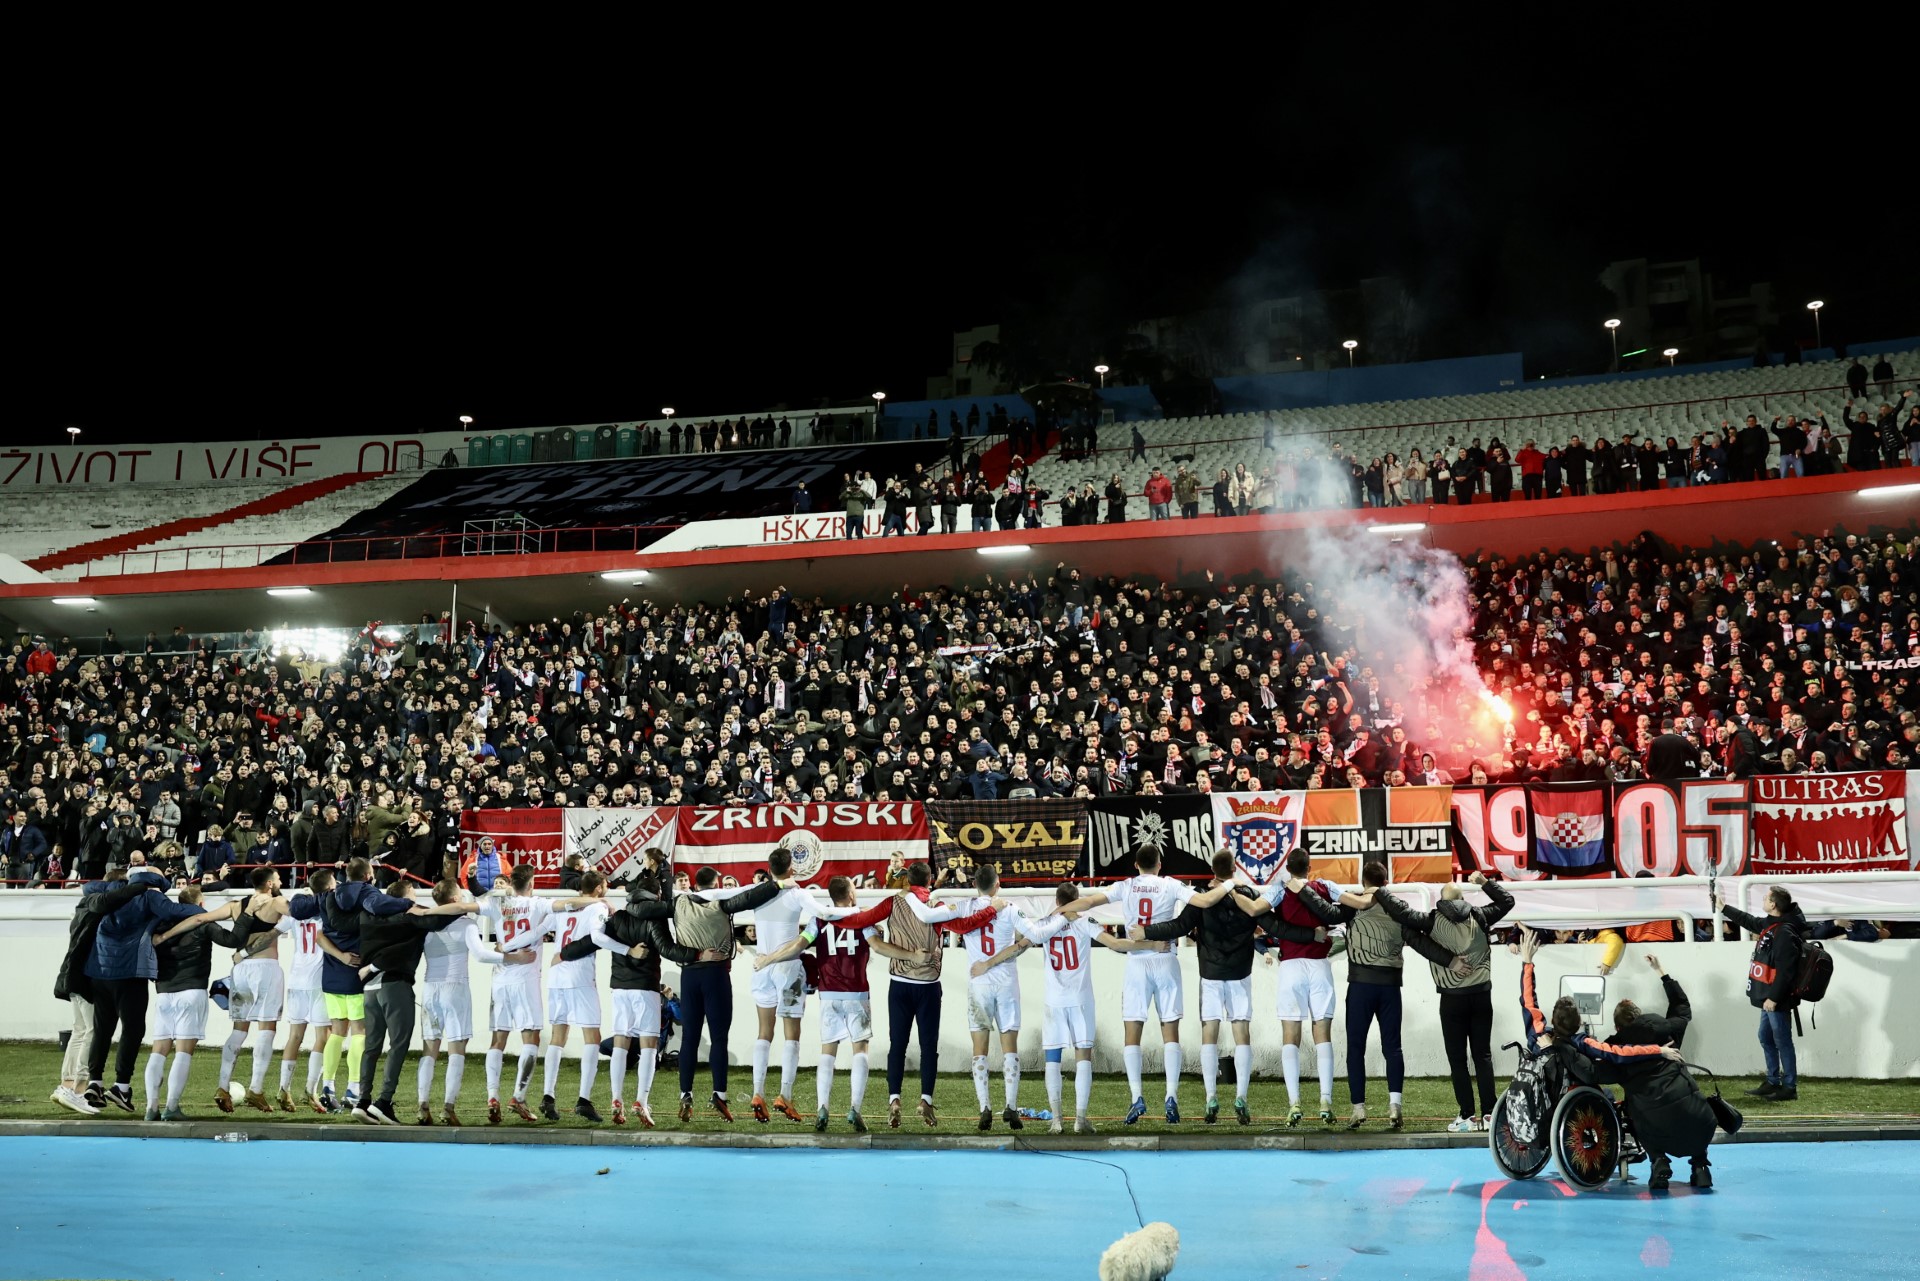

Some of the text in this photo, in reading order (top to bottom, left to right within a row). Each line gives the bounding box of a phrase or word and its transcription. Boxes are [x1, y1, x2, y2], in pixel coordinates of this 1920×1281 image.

[0, 440, 424, 484] ŽIVOT I VIŠE OD
[763, 511, 919, 542] HŠK ZRNJKI
[1757, 775, 1884, 801] ULTRAS
[691, 803, 914, 831] ZRINJSKI
[1237, 804, 1281, 815] ZRINJSKI
[596, 812, 664, 875] RINJSKI
[932, 820, 1084, 850] LOYAL
[1308, 828, 1447, 853] ZRINJEVCI
[462, 837, 562, 871] tras
[948, 854, 1076, 875] stt thugs
[1138, 898, 1153, 926] 9
[300, 923, 317, 954] 17
[820, 921, 860, 956] 14
[979, 922, 996, 957] 6
[1049, 935, 1079, 971] 50
